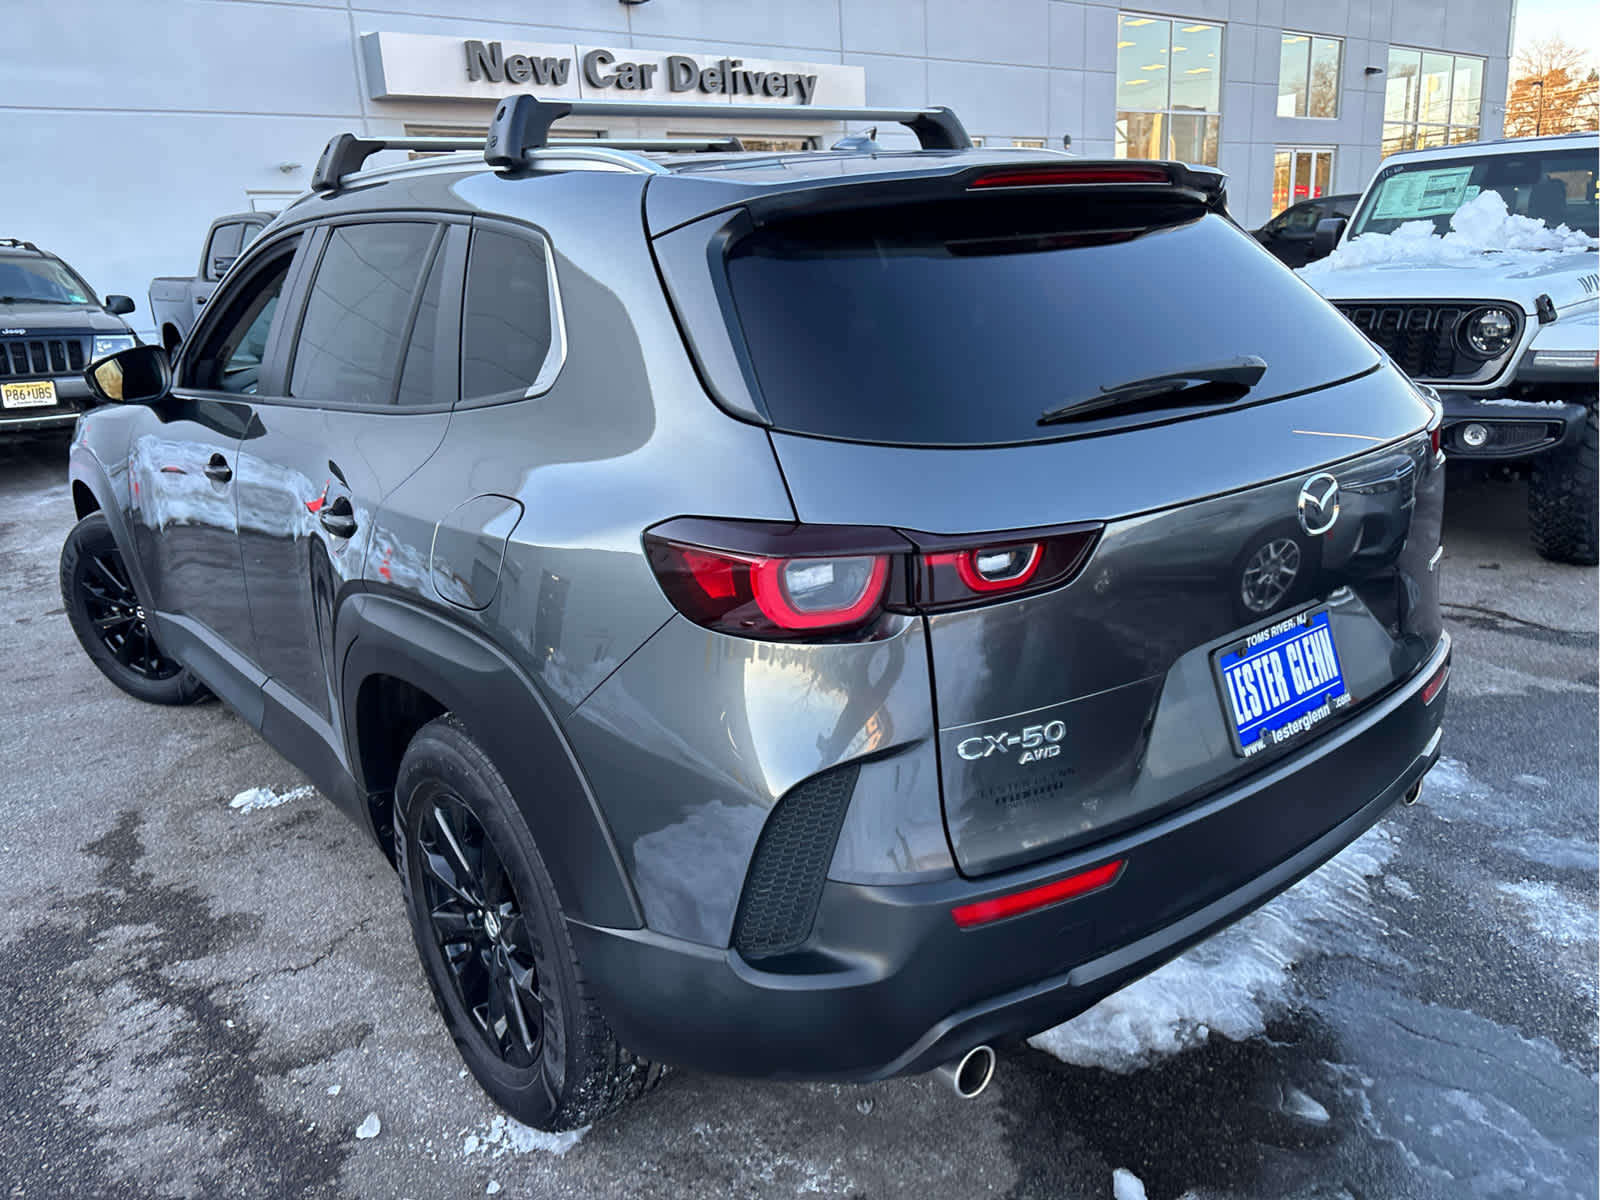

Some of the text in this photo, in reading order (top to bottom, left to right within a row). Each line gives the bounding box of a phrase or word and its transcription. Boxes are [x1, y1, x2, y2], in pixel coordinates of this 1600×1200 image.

[464, 40, 819, 105] New Car Delivery
[1246, 629, 1270, 648] TOMS
[1297, 612, 1307, 627] NJ
[1225, 628, 1339, 726] LESTER GLENN
[957, 720, 1066, 760] CX-50
[1018, 745, 1061, 765] AWD
